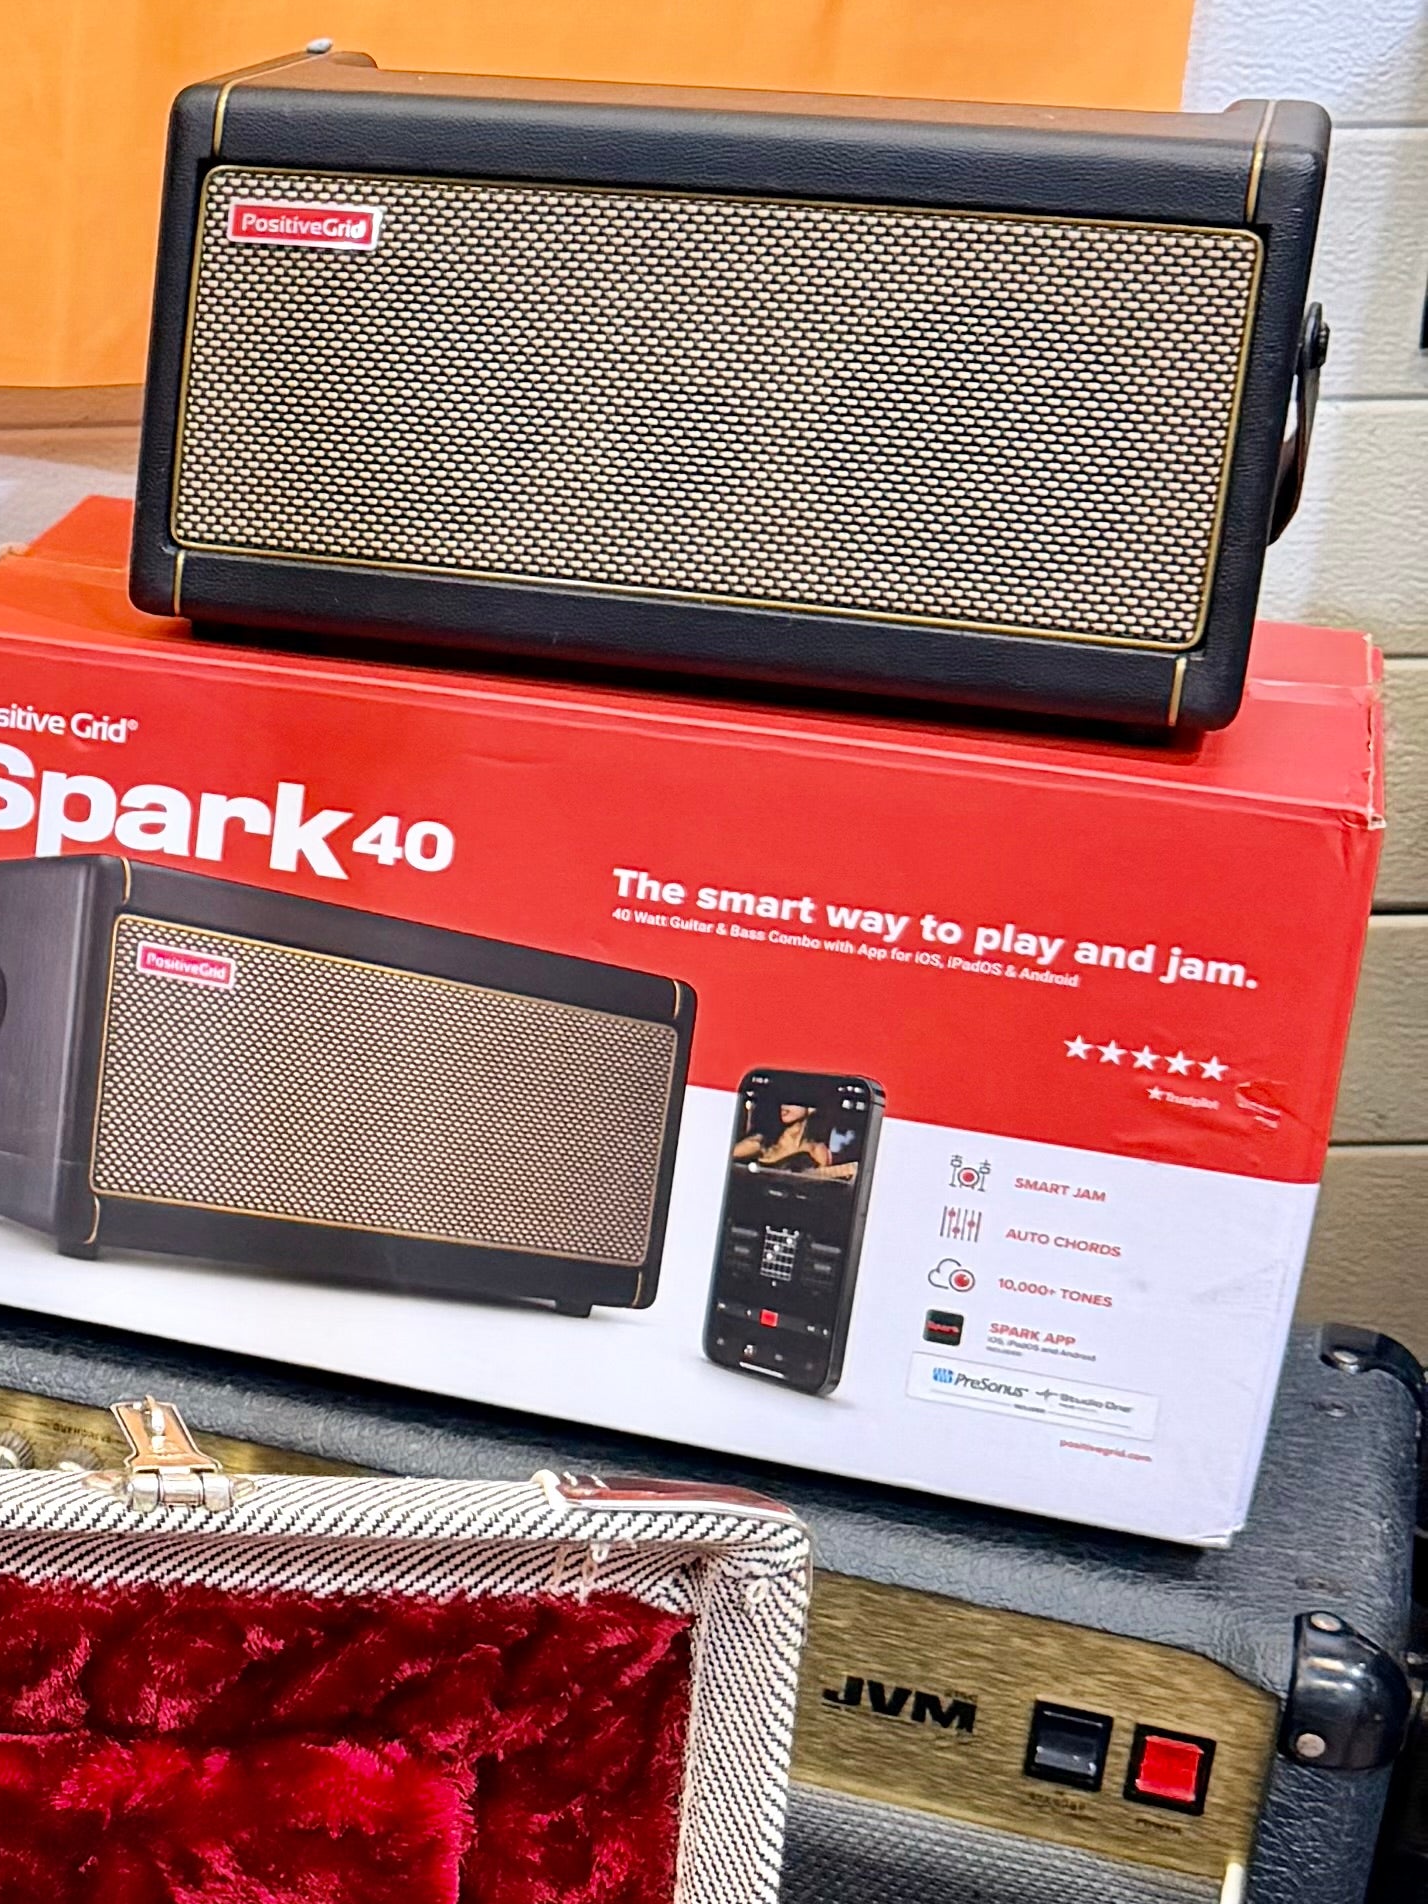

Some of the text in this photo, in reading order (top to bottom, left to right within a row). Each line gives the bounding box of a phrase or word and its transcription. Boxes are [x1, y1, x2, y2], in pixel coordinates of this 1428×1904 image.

[241, 212, 366, 239] PositiveGrid
[352, 816, 456, 873] 40
[612, 868, 1259, 990] The smart way to play and jam.
[612, 907, 1080, 988] 40 Watt Guitar & Bass Combo with App for iOS, iPadOS & Android
[145, 951, 227, 980] PositiveGrid
[1014, 1177, 1107, 1203] SMART JAM
[1005, 1228, 1122, 1258] AUTO CHORDS
[1060, 1288, 1113, 1308] TONES
[989, 1322, 1077, 1346] SPARK APP
[821, 1675, 978, 1734] JVM
